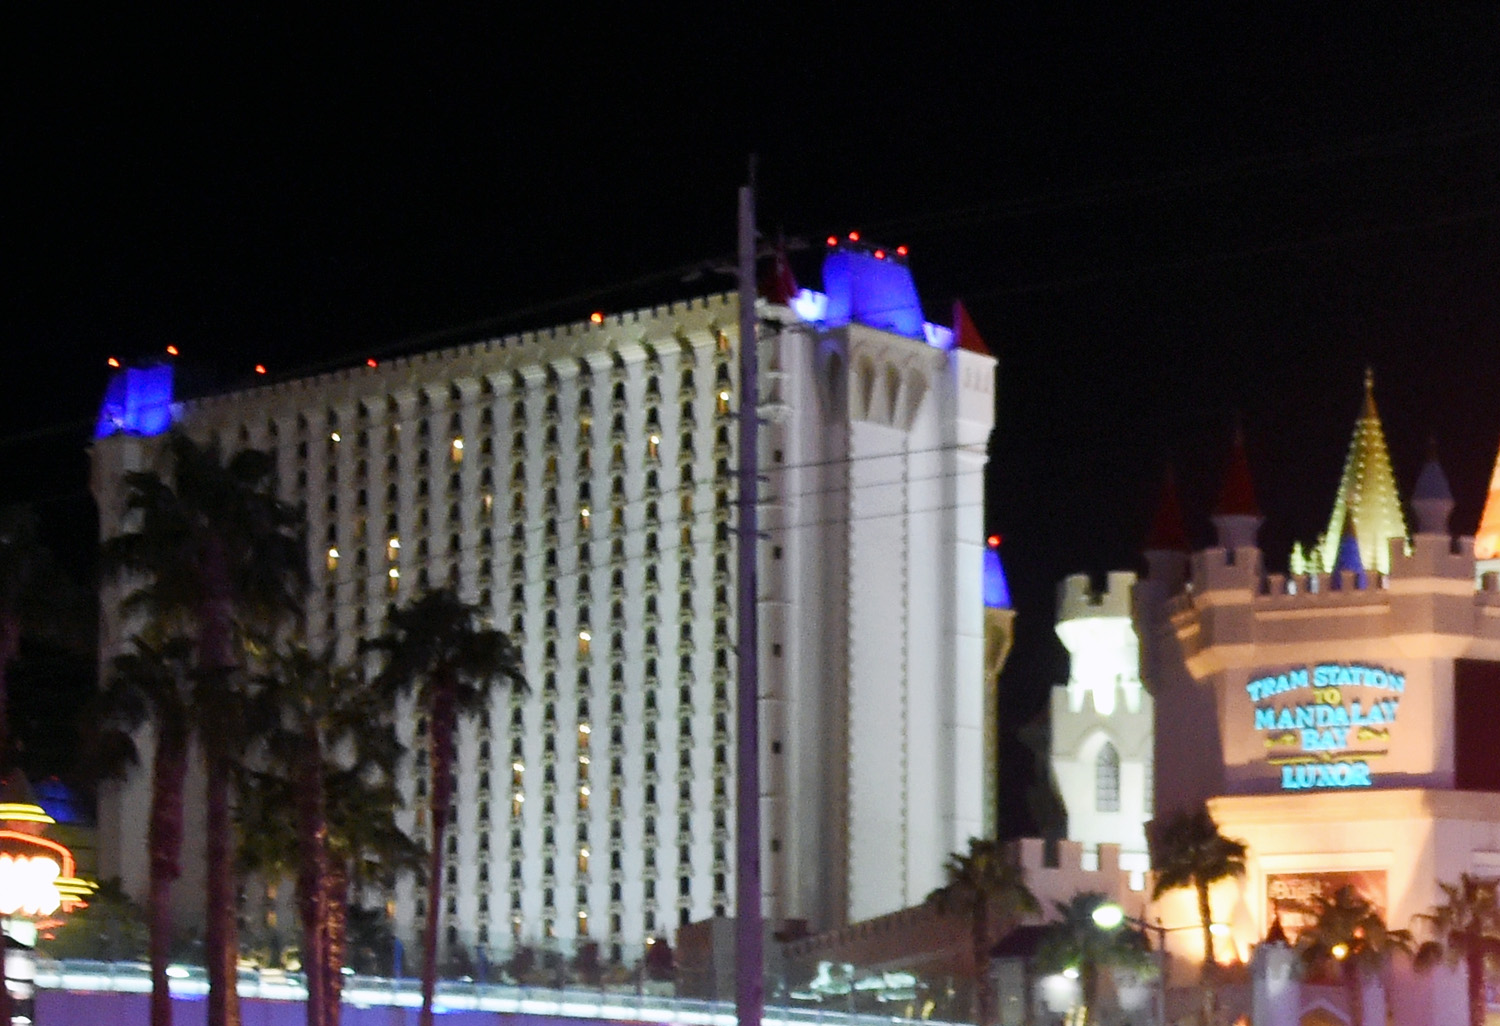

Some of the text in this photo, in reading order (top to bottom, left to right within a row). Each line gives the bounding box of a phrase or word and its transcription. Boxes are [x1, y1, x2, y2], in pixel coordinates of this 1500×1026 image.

[1246, 664, 1406, 702] TRAM STATION
[1314, 687, 1342, 705] TO
[1255, 701, 1399, 730] MANDALAY
[1301, 727, 1350, 750] BAY
[1282, 762, 1372, 789] LUXOR
